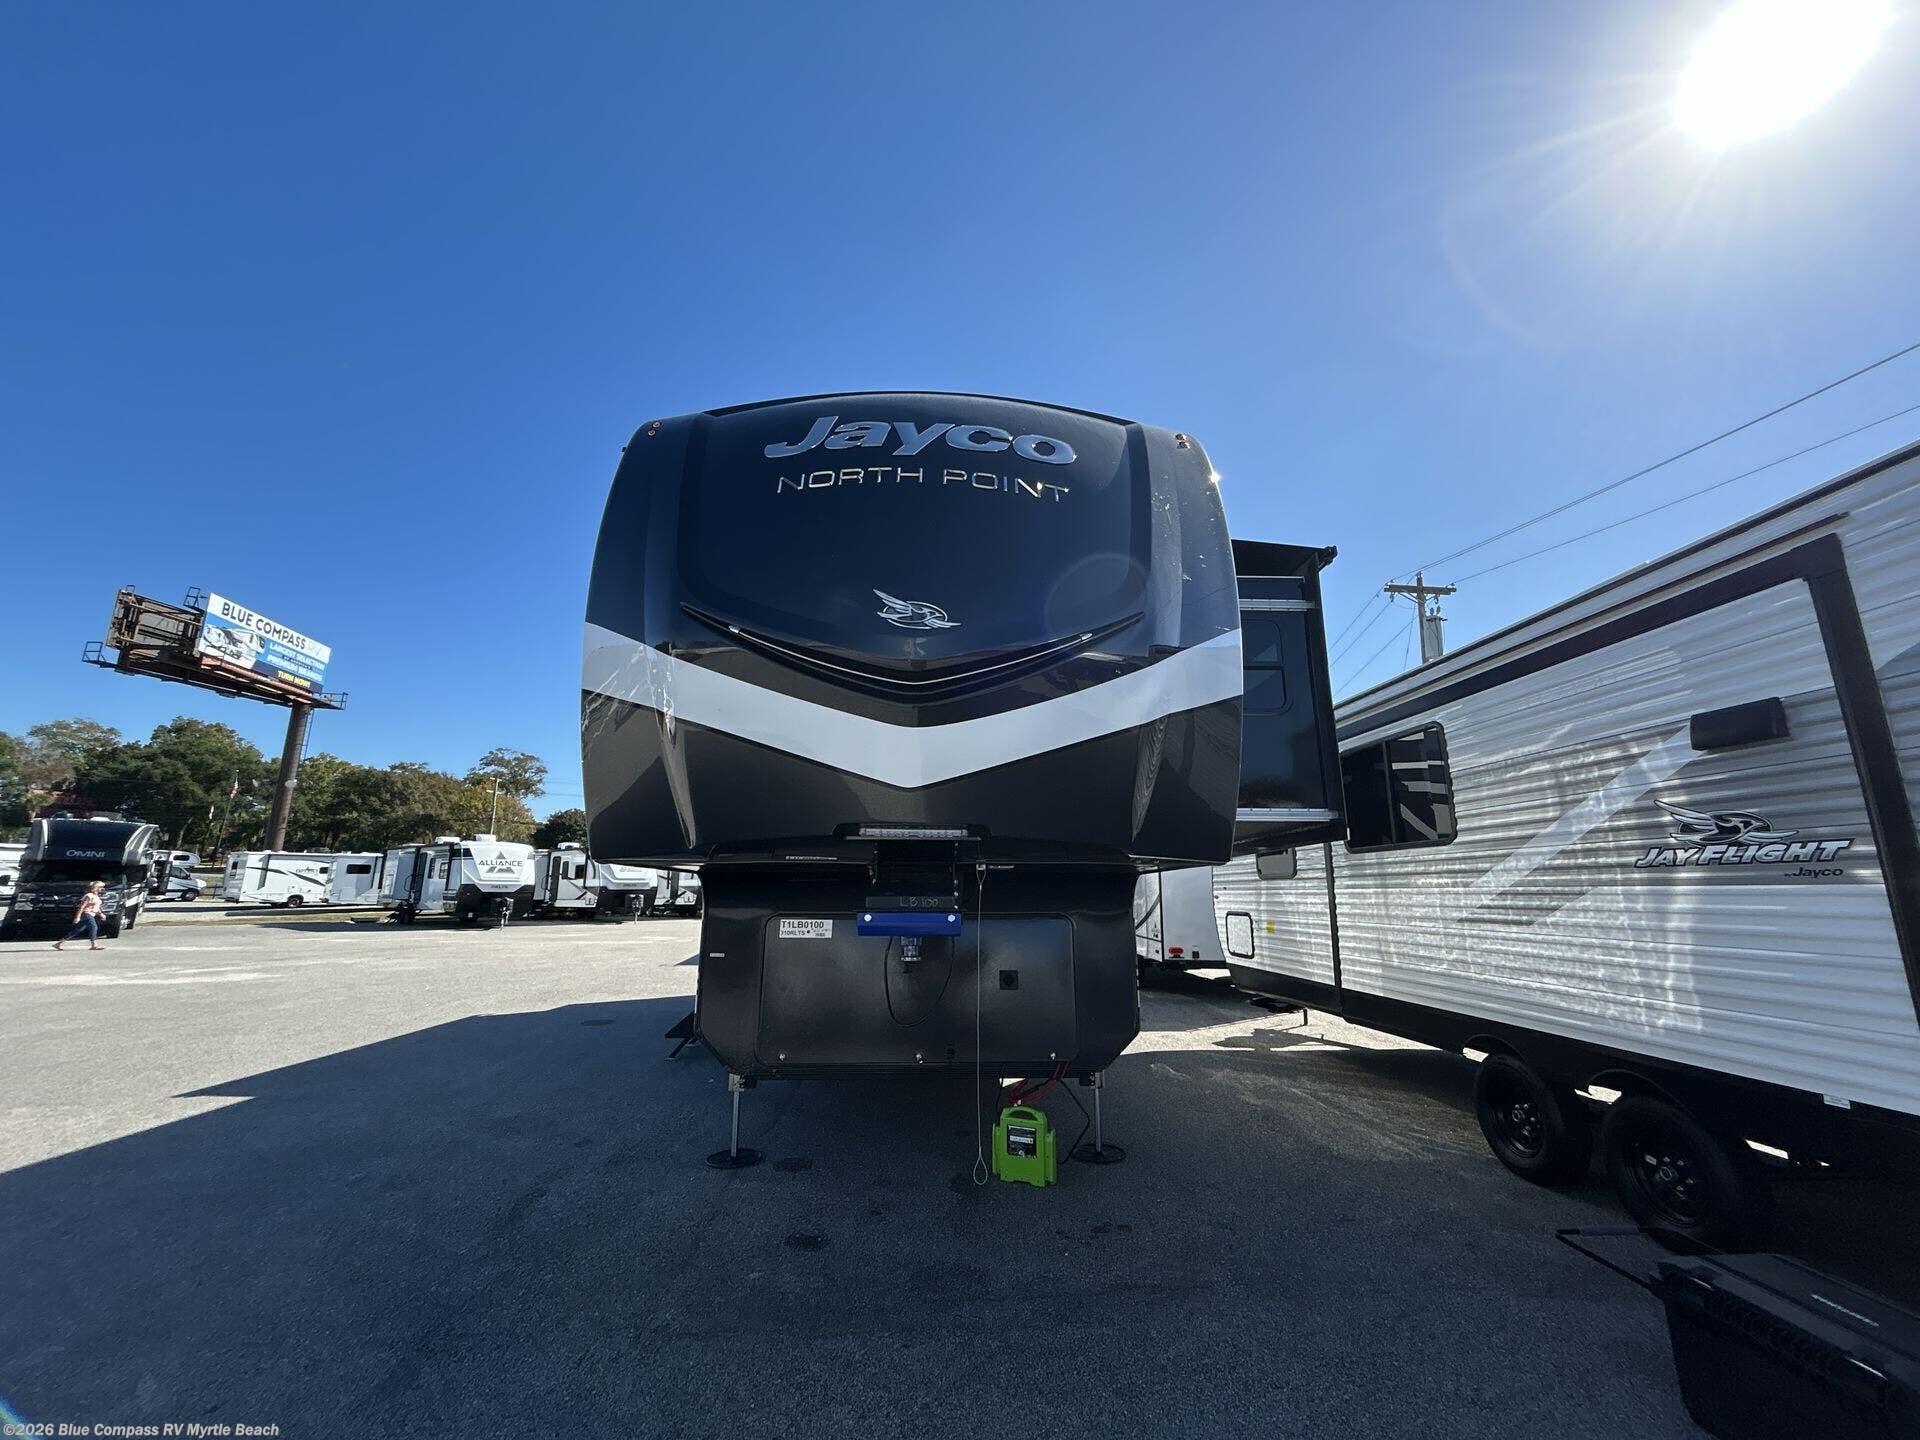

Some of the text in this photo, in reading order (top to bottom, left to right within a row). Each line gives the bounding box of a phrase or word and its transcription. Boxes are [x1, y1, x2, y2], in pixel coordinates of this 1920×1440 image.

[764, 416, 1077, 465] Jayco
[777, 466, 1069, 502] NORTH POINT
[222, 602, 254, 626] BLUE
[255, 618, 307, 650] COMPASS
[66, 849, 106, 858] OMNI
[1792, 867, 1843, 879] Jayco
[781, 920, 825, 929] T1LB0100
